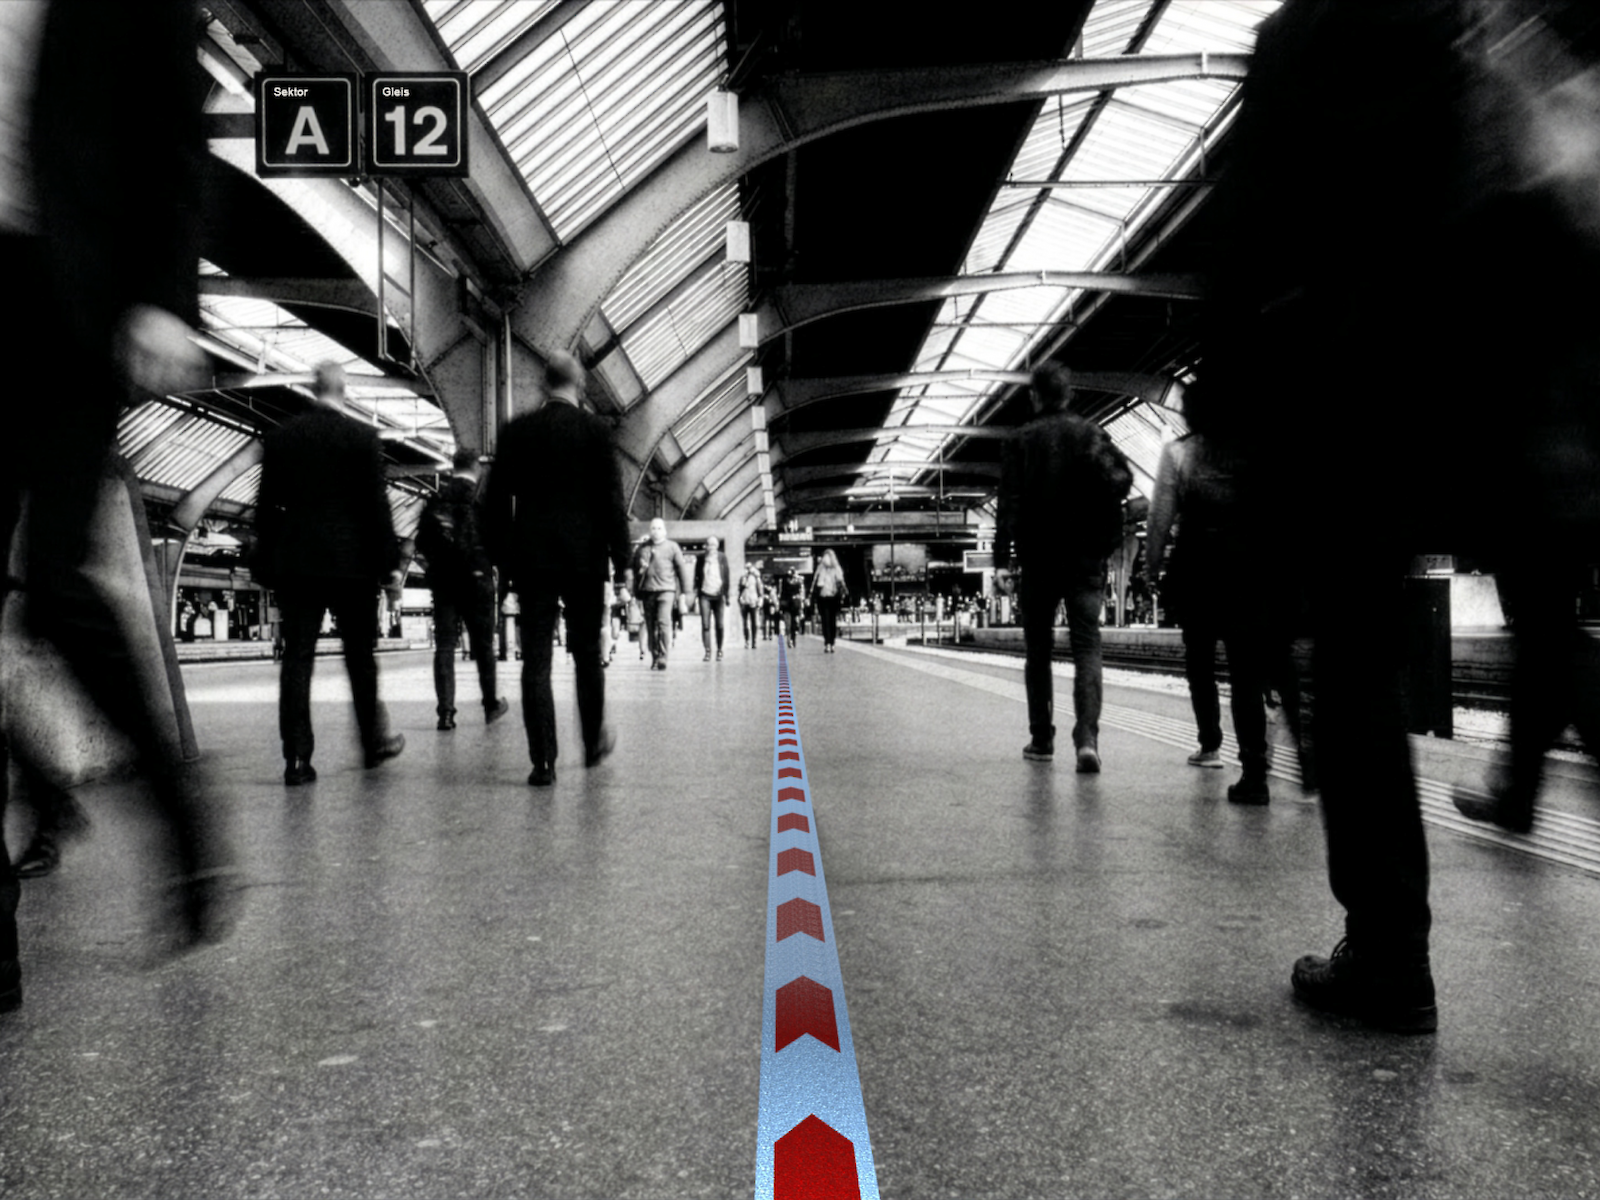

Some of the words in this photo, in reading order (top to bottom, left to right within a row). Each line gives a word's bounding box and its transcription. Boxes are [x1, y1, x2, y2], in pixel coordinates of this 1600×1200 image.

[273, 86, 309, 97] Sektor
[382, 86, 410, 97] Gleis
[285, 105, 330, 155] A
[384, 105, 448, 156] 12
